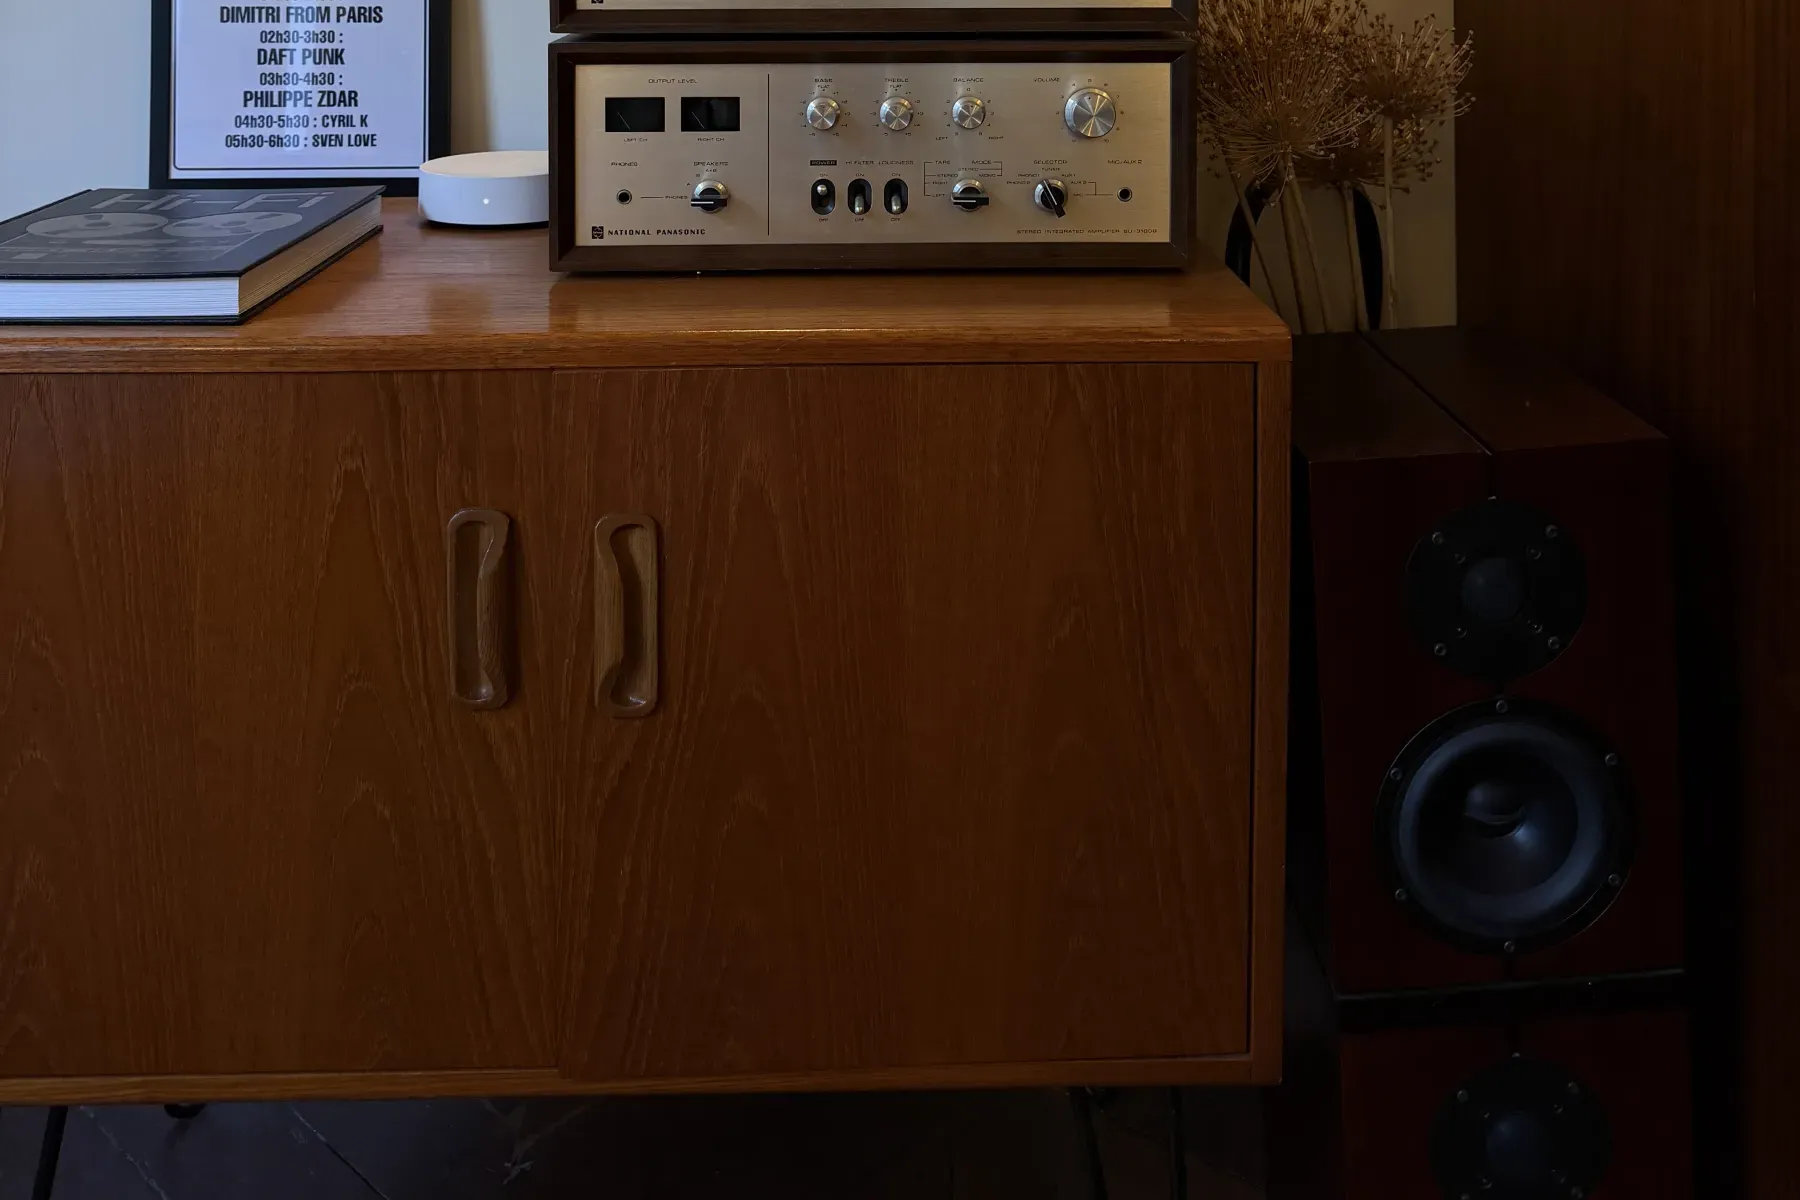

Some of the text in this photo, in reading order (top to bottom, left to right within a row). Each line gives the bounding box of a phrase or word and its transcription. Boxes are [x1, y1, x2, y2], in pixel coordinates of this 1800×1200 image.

[220, 5, 384, 24] DIMITRI FROM PARIS
[260, 30, 335, 44] 02h30-3h30
[257, 48, 345, 66] DAFT PUNK
[259, 72, 334, 86] 03h30-4h30
[243, 90, 358, 108] PHILIPPE ZDAR
[235, 114, 309, 129] 04h30-5h30
[322, 114, 356, 129] CYRIL
[359, 114, 368, 128] K
[225, 133, 300, 148] 05h30-6h30
[312, 133, 343, 148] SVEN
[347, 133, 377, 148] LOVE
[91, 191, 335, 211] Hi-Fi
[656, 228, 706, 236] PANASONIC
